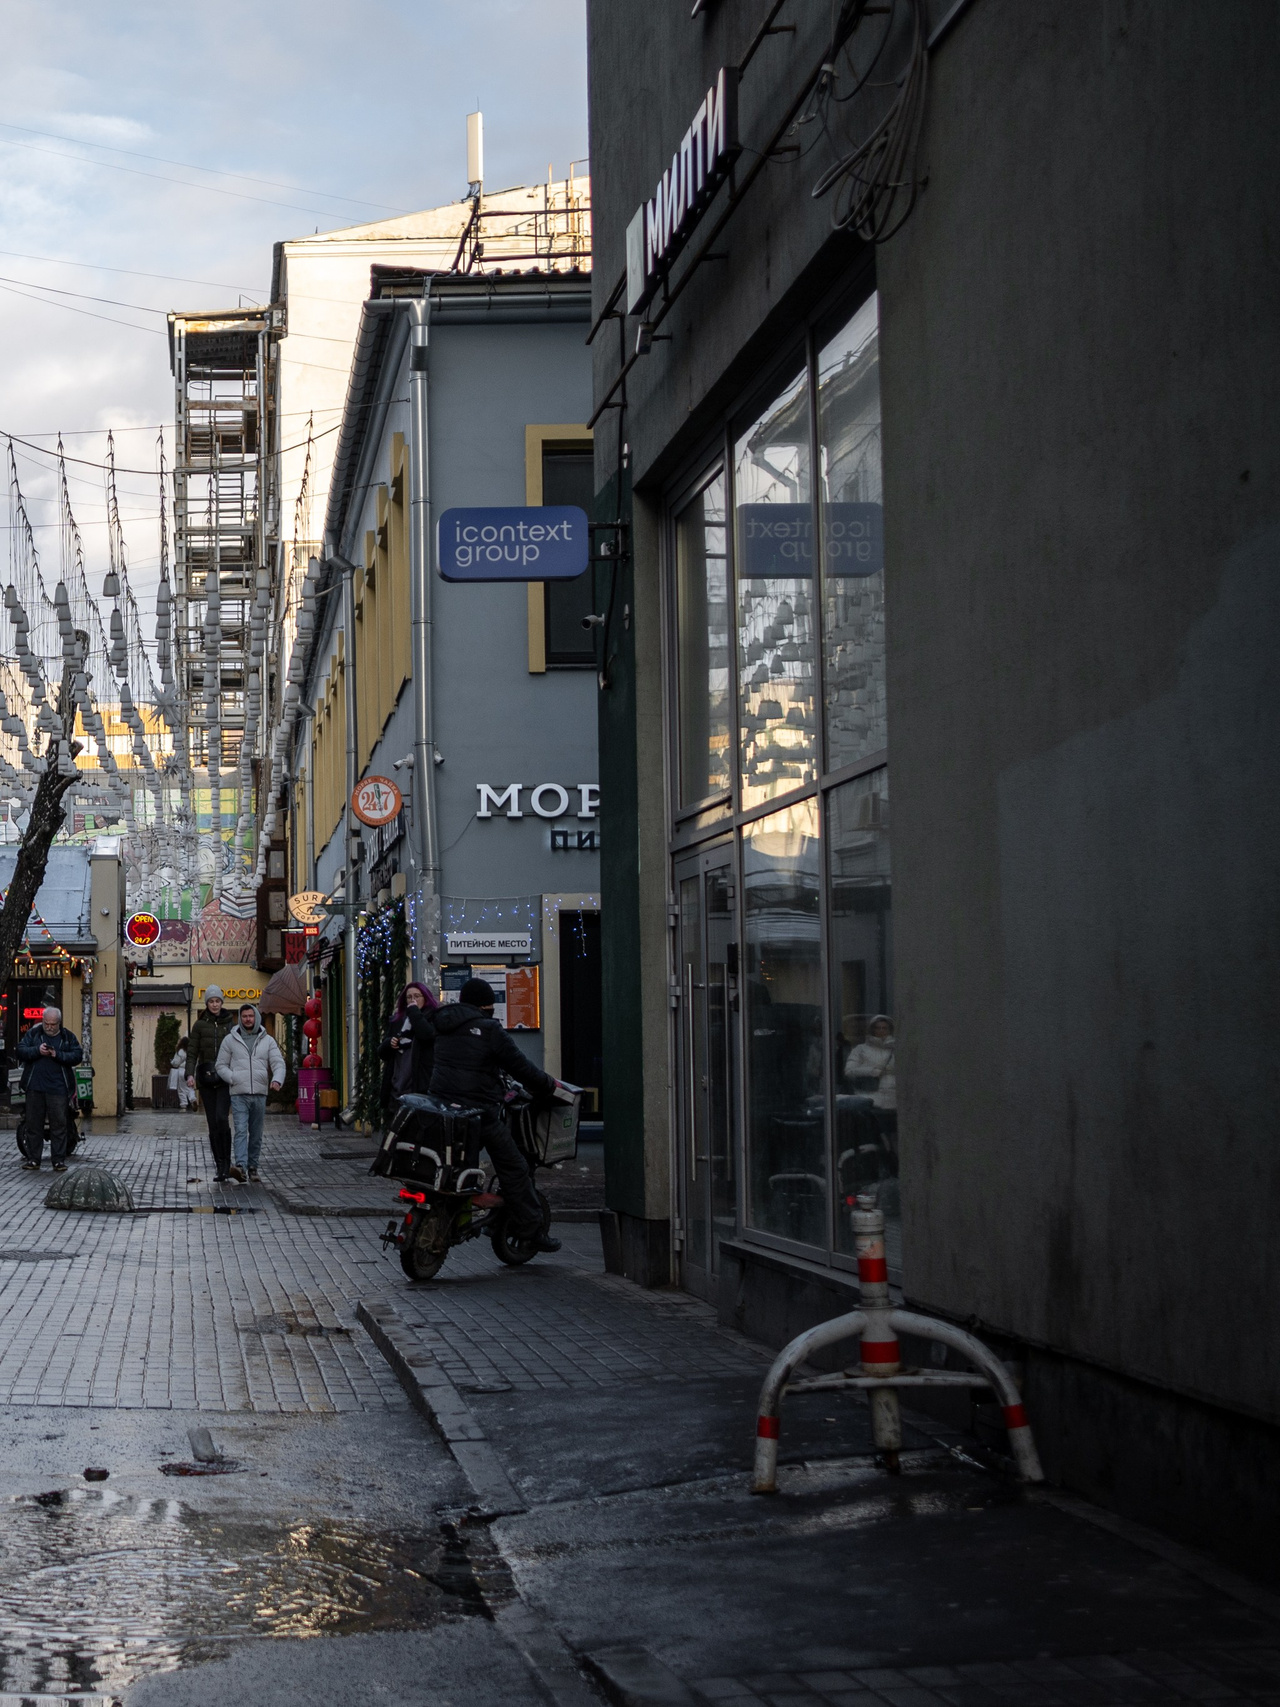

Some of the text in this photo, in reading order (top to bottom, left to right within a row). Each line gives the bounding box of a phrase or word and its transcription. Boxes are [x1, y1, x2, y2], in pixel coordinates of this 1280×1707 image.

[647, 67, 726, 276] МИЛТИ
[456, 520, 572, 542] icontext
[455, 544, 540, 567] group
[294, 894, 320, 905] SUR
[134, 915, 154, 923] OPEN
[134, 936, 151, 944] 24/7
[450, 938, 528, 948] ПИТЕЙНОЕ МЕСТО
